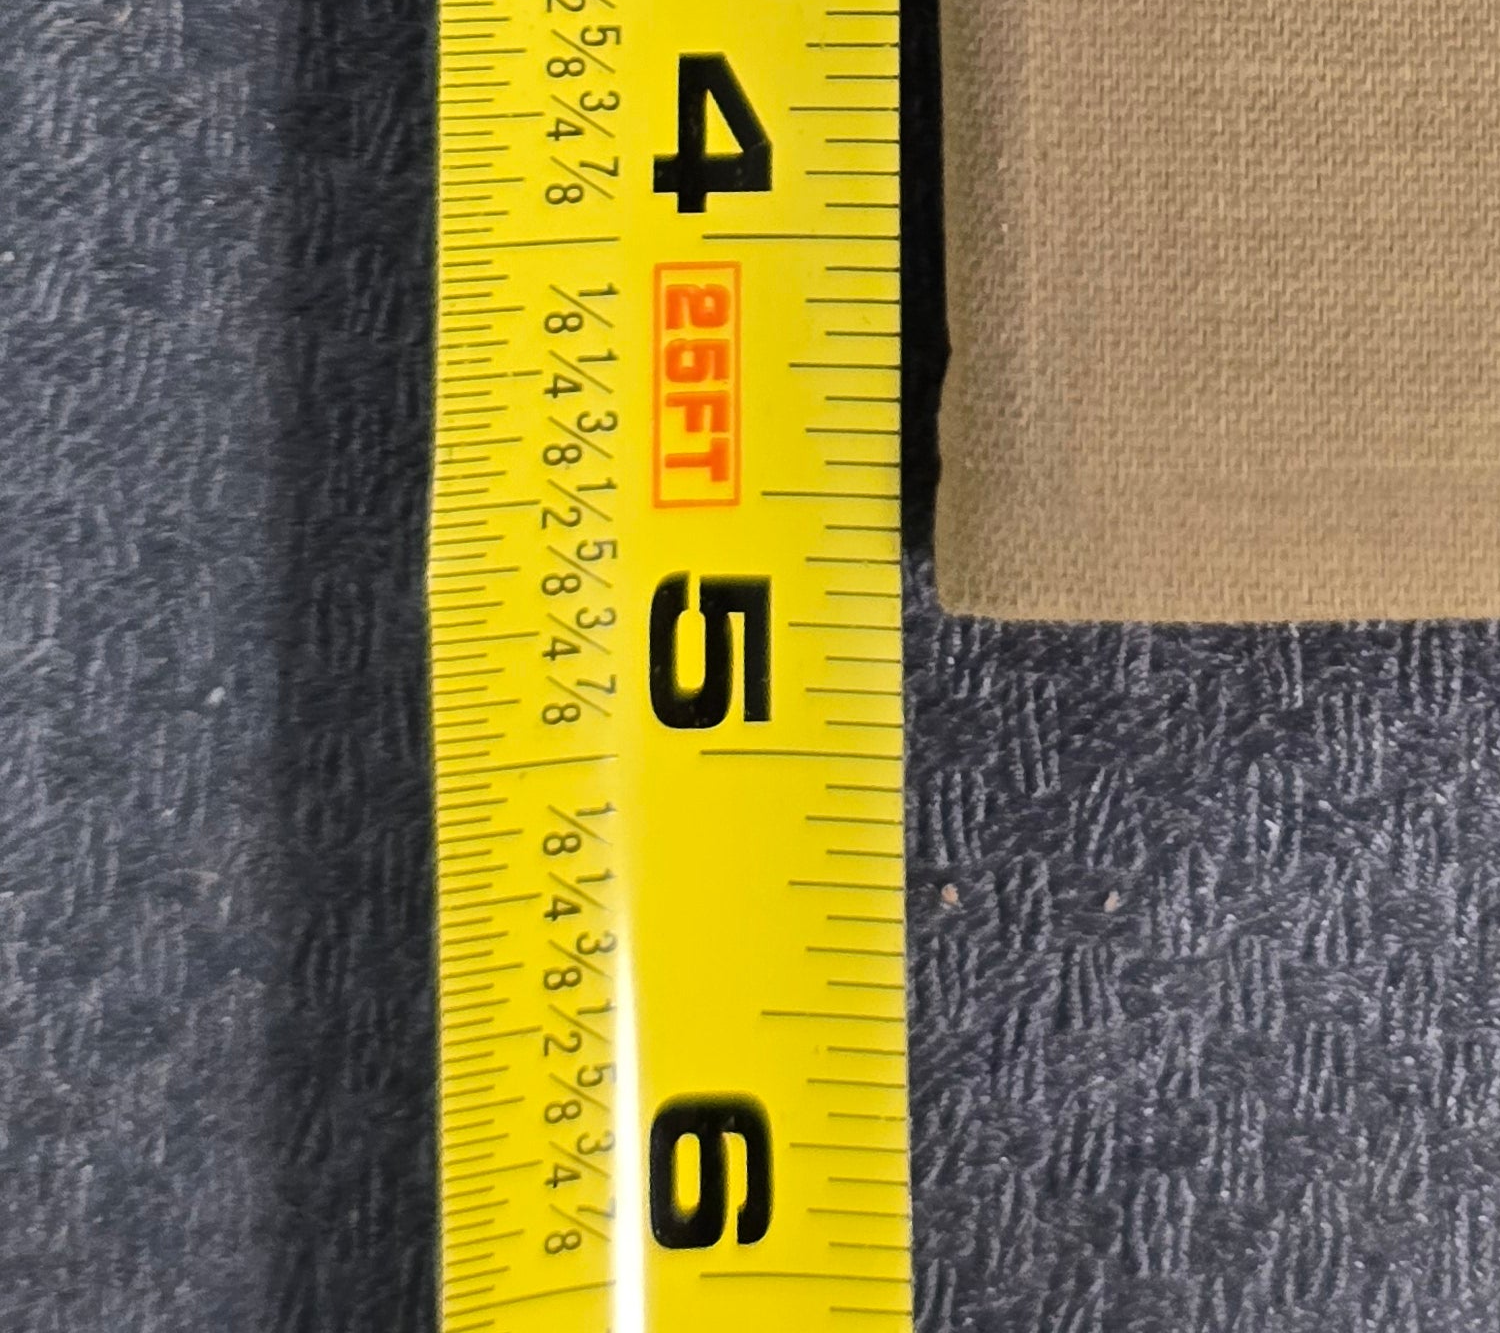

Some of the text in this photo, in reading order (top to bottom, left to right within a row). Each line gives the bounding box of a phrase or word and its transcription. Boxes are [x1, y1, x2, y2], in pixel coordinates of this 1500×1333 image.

[546, 25, 621, 78] 5/8
[546, 90, 621, 141] 3/4
[545, 156, 620, 205] 7/8
[653, 51, 773, 213] 4
[665, 283, 731, 483] 25FT
[542, 284, 619, 725] 1/8 1/4 3/8 1/2 5/8 3/4 7/8
[650, 570, 772, 729] 5
[543, 802, 617, 1255] 1/8 1/4 3/8 1/2 5/8 3/4 7/8
[650, 1089, 774, 1249] 6
